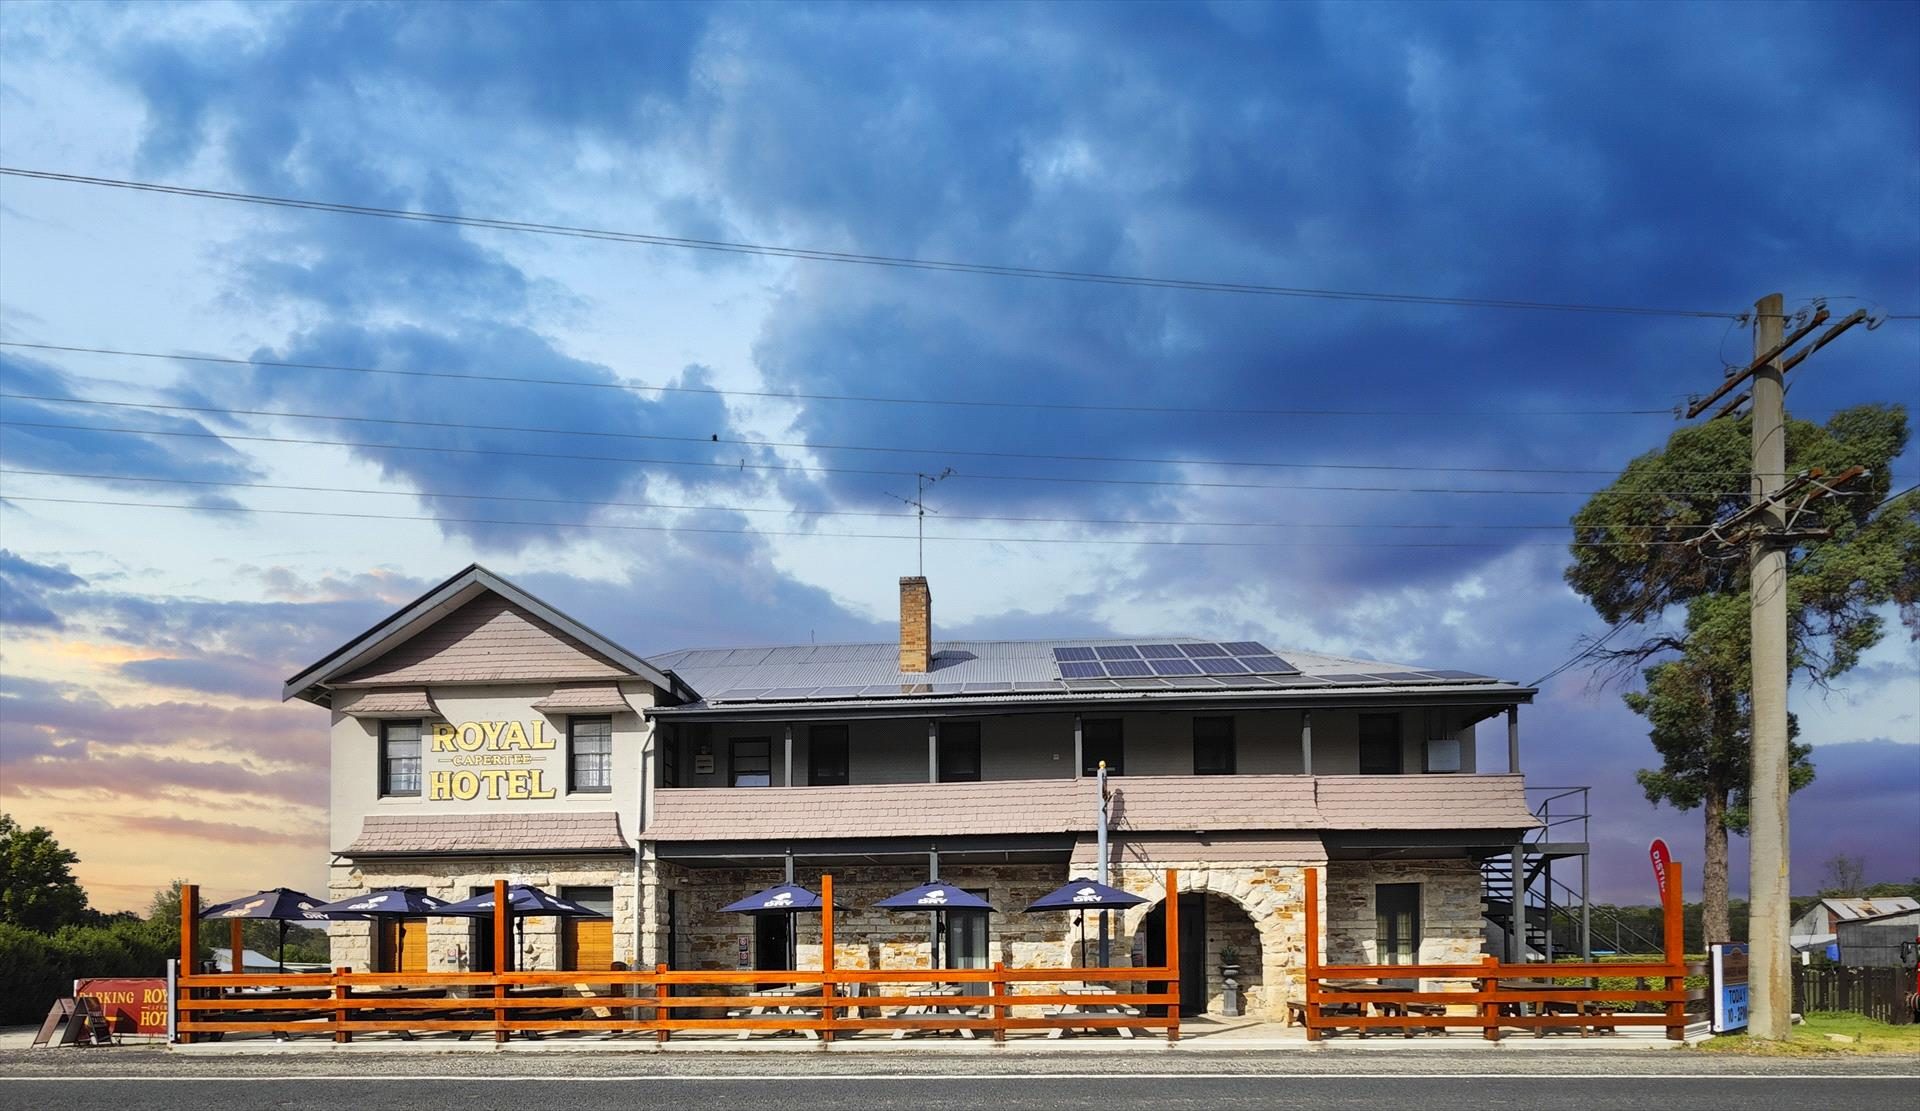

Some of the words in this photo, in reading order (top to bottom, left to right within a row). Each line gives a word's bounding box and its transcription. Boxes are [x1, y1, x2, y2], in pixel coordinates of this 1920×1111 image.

[431, 720, 556, 752] ROYAL
[453, 754, 531, 766] CAPERTEE
[429, 769, 556, 801] HOTEL
